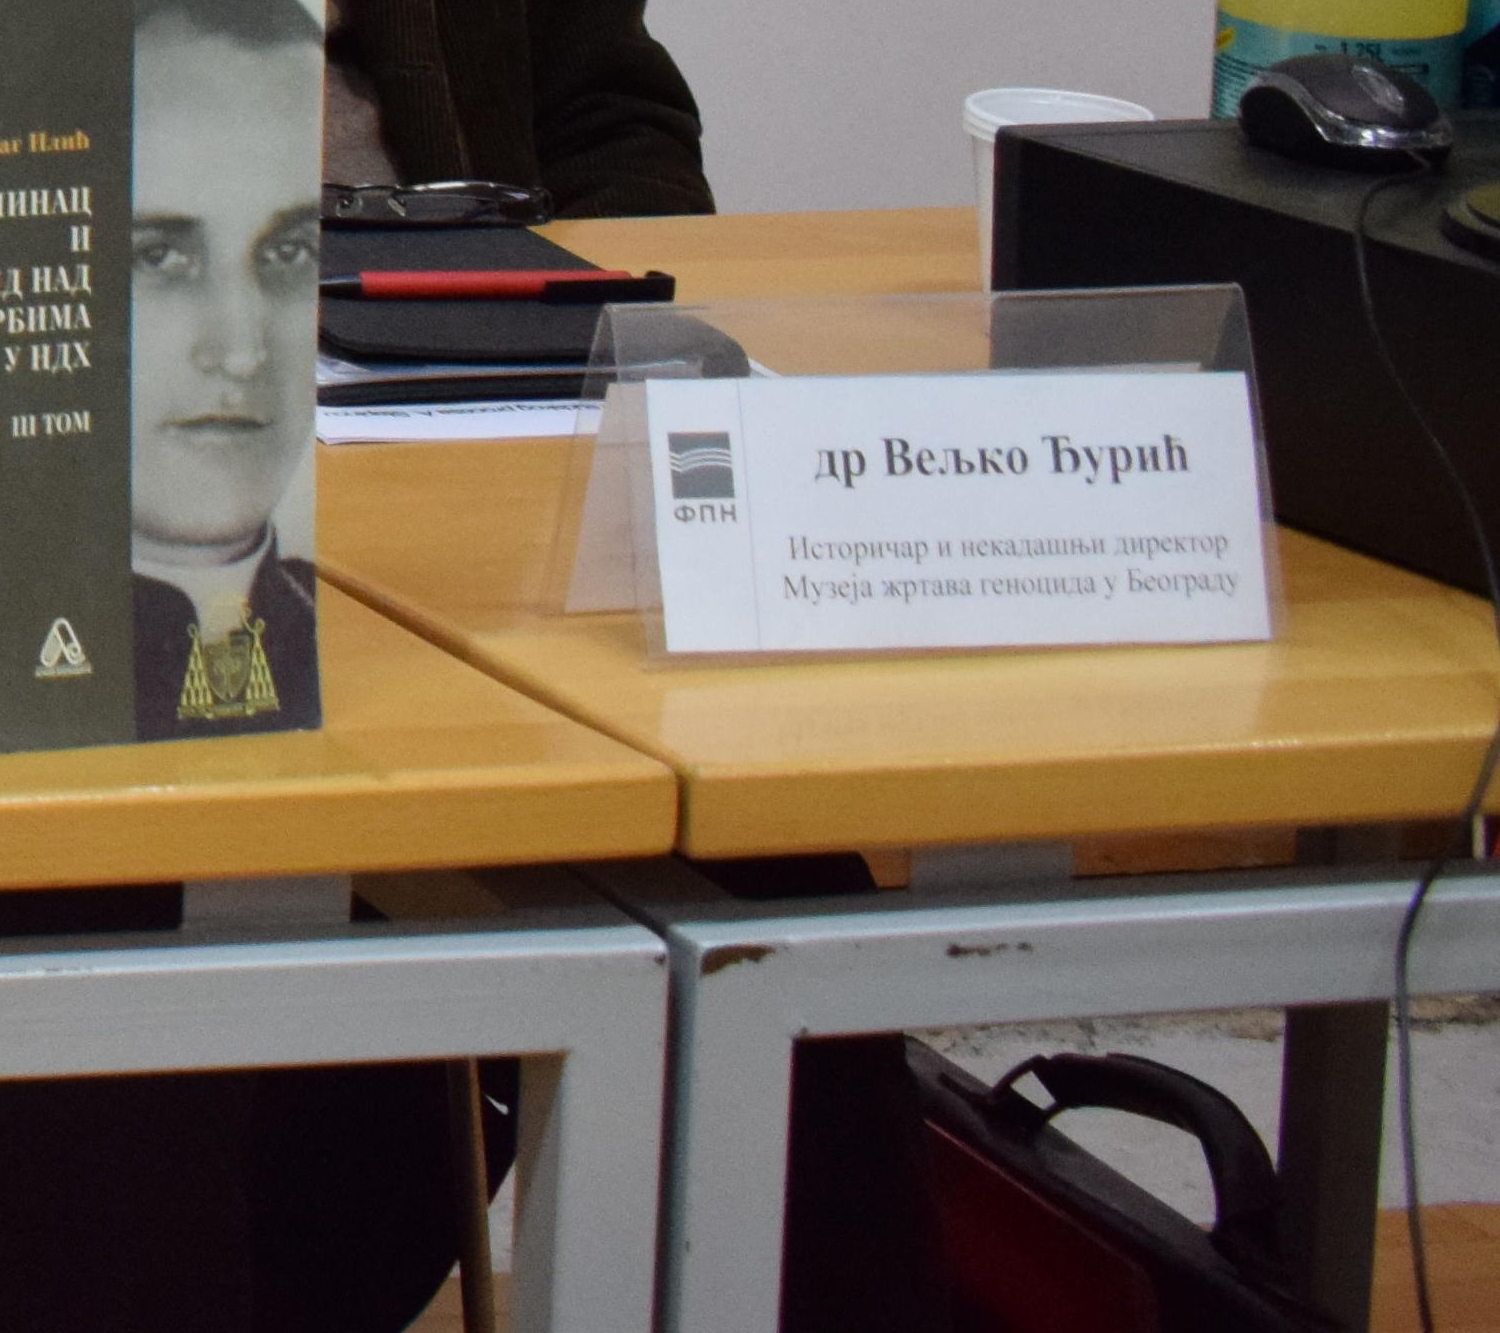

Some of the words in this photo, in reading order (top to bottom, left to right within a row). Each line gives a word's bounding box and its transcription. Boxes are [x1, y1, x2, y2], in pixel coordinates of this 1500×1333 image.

[29, 129, 90, 154] Илић
[70, 225, 91, 252] И
[31, 264, 92, 297] НАД
[4, 345, 21, 372] У
[30, 341, 91, 374] НДХ
[43, 410, 91, 435] ТОМ
[815, 450, 866, 488] др
[883, 438, 1028, 476] Вељко
[1042, 434, 1189, 485] Ђурић
[674, 503, 737, 523] ФПН
[789, 536, 929, 566] Историчар
[937, 541, 952, 557] и
[961, 538, 1106, 558] некадашњи
[1115, 534, 1230, 560] директор
[783, 573, 874, 606] Музеја
[882, 579, 972, 604] жртава
[980, 576, 1097, 596] геноцида
[1103, 576, 1117, 600] у
[1127, 568, 1239, 599] Београду
